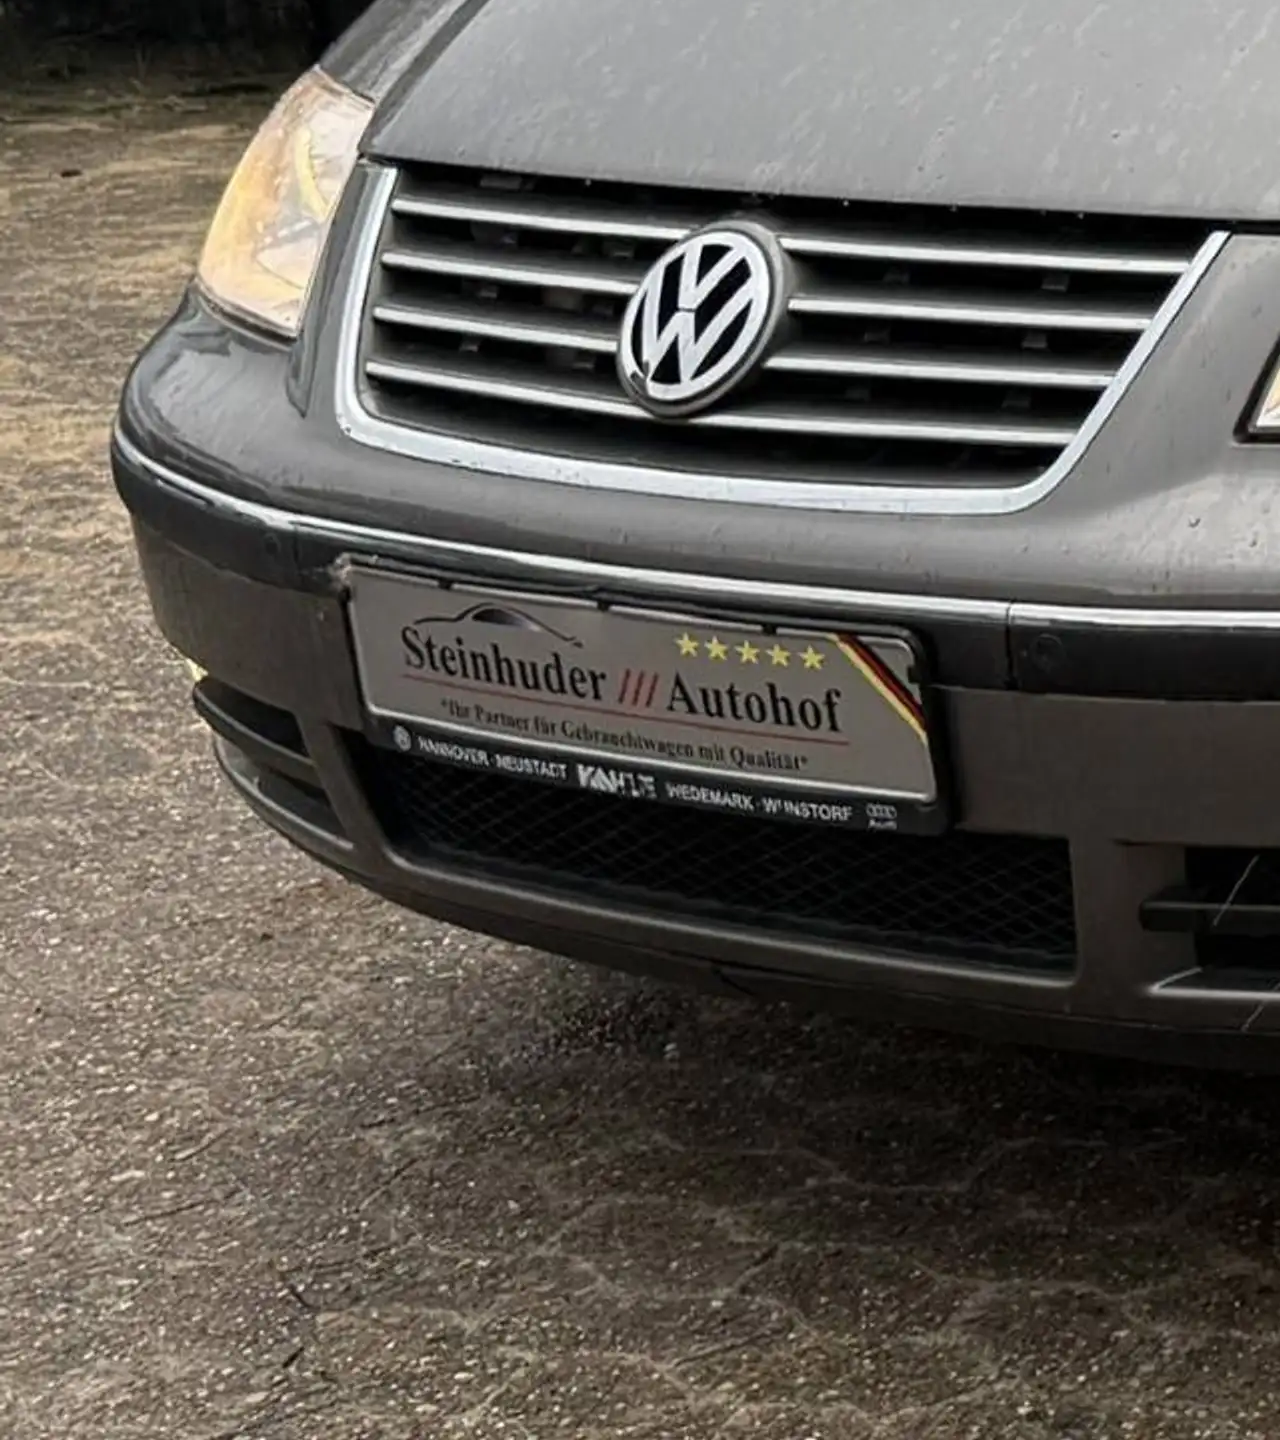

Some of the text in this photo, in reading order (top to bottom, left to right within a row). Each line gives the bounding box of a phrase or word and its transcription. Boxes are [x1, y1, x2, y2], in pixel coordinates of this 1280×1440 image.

[401, 626, 606, 700] Steinhuder
[667, 670, 841, 731] Autohof
[474, 704, 529, 731] Partner
[561, 720, 693, 758] Gebrauchtwagen
[699, 741, 725, 762] mit
[664, 781, 755, 811] WEDEMARK
